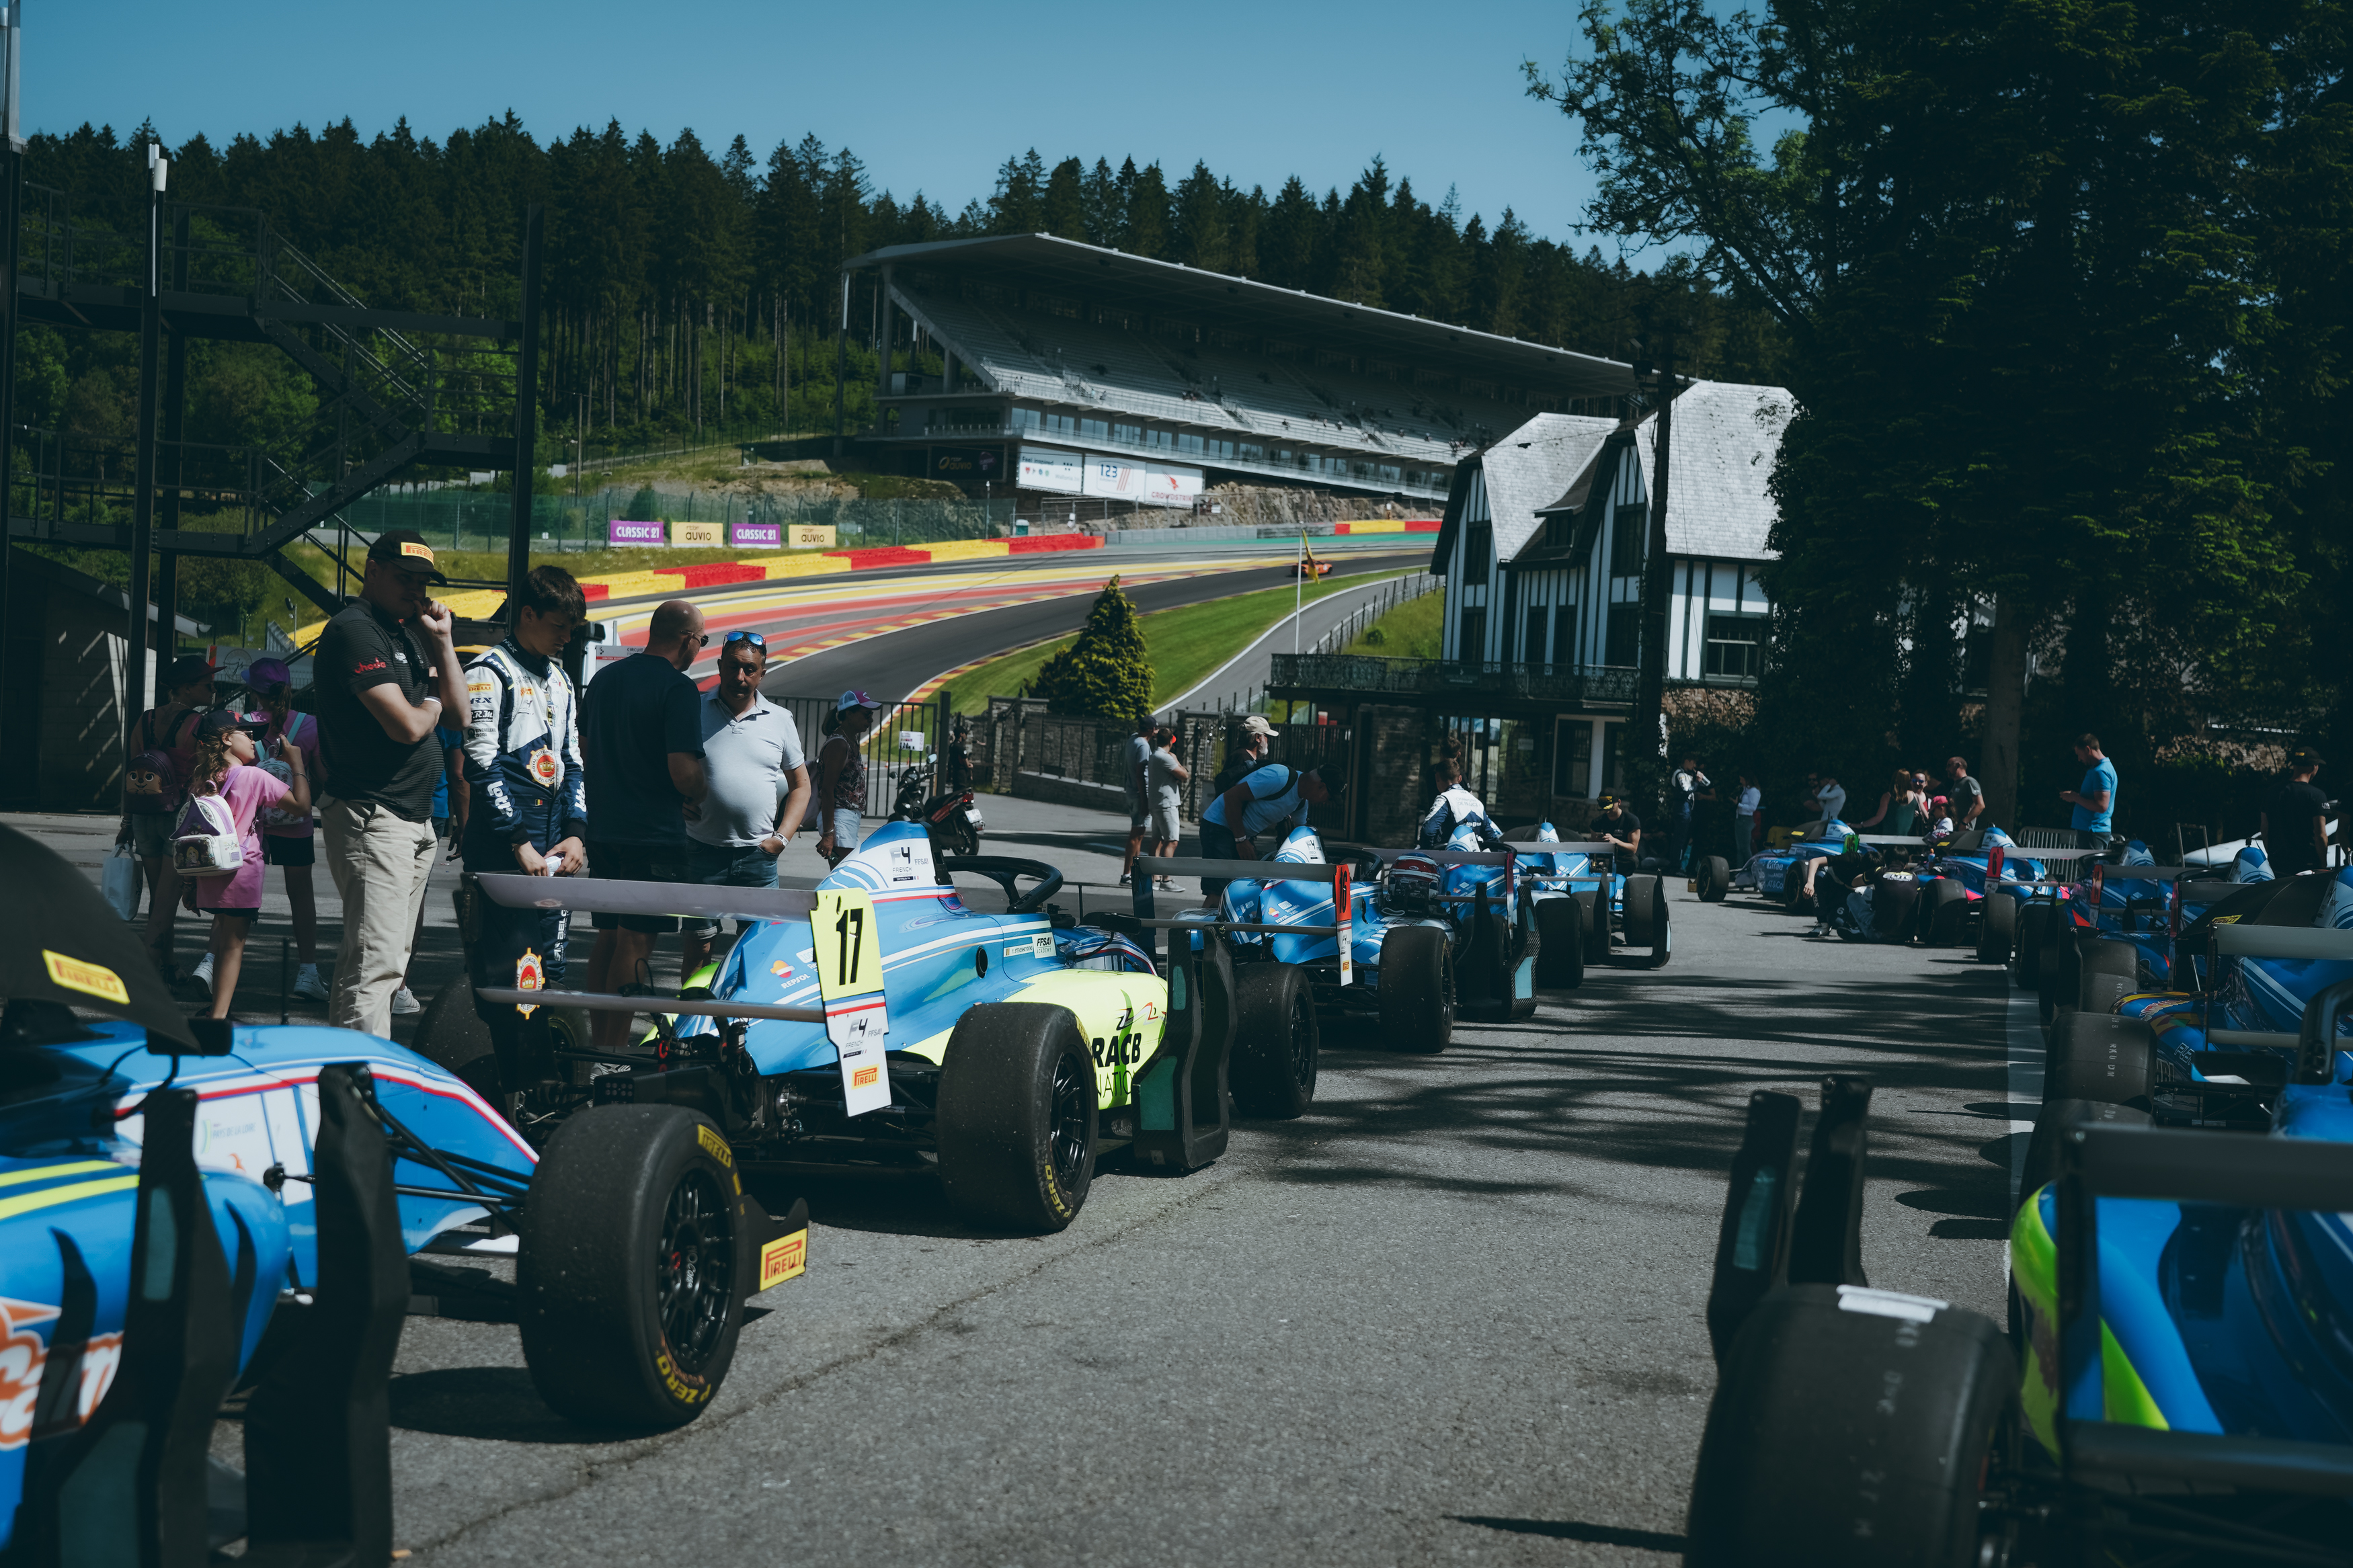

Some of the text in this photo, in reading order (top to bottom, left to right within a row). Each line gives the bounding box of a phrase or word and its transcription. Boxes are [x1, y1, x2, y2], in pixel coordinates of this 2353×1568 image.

[1101, 464, 1117, 478] 123
[1152, 491, 1193, 502] CROWDSTRIK
[616, 526, 660, 538] CLASSIC 21
[686, 532, 711, 540] auvio
[737, 528, 777, 540] CLASSIC 21
[801, 534, 825, 542] auvio
[487, 780, 513, 817] Lotto
[889, 846, 911, 866] F4
[1339, 868, 1347, 914] 16
[836, 908, 864, 986] 17
[54, 958, 120, 995] PIRELLI
[781, 973, 811, 989] REPSOL
[847, 1018, 869, 1040] F4
[845, 1040, 863, 1048] FRENCH
[1092, 1032, 1142, 1068] RACB
[854, 1067, 877, 1086] PIRELLI
[212, 1128, 226, 1139] PAYS
[227, 1126, 235, 1137] DE
[243, 1123, 257, 1134] LOIRE
[697, 1124, 731, 1168] PIRELLI
[1045, 1164, 1066, 1213] ZERO
[765, 1239, 802, 1280] PIRELLI
[657, 1354, 699, 1404] ZERO
[699, 1383, 711, 1403] P
